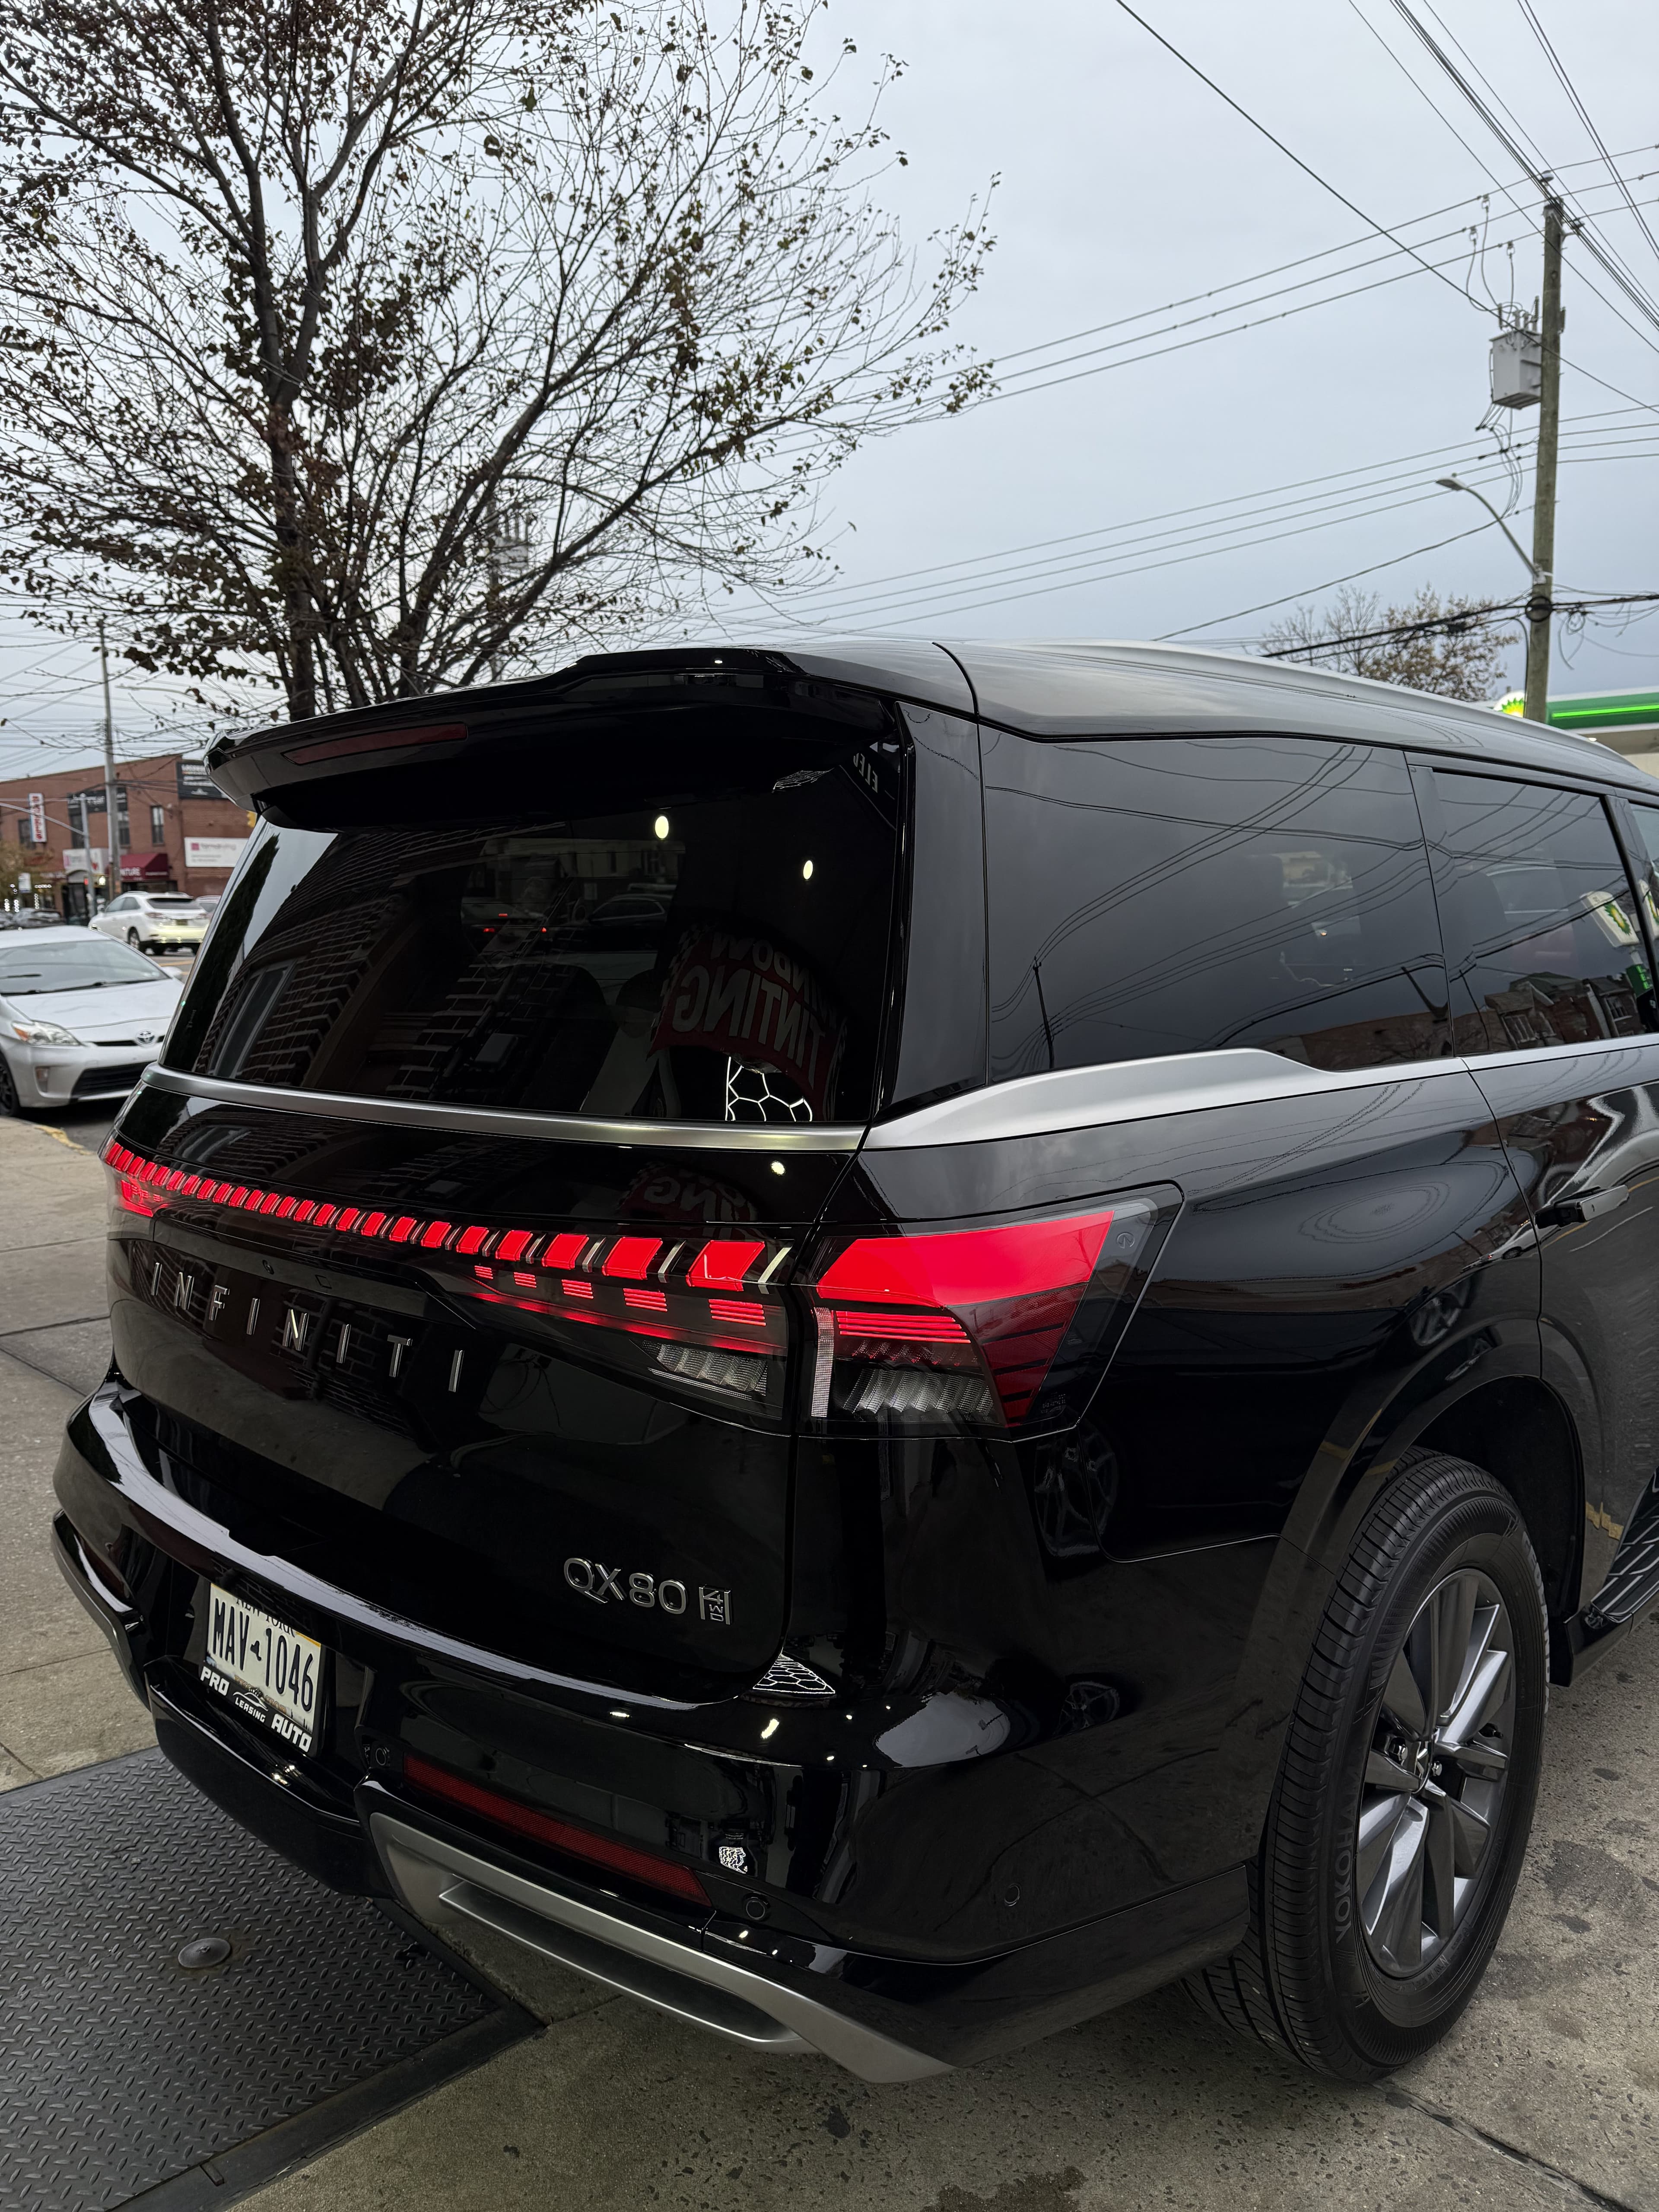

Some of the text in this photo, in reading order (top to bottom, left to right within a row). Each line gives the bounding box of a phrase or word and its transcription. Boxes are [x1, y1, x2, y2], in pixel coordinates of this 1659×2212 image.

[150, 1262, 464, 1392] INFINITI
[564, 1557, 689, 1615] QX80
[213, 1598, 313, 1712] MAV 1046
[200, 1666, 312, 1753] PRO AUTO
[235, 1697, 266, 1723] LEASING
[1334, 1762, 1361, 1945] YOKOHAM
